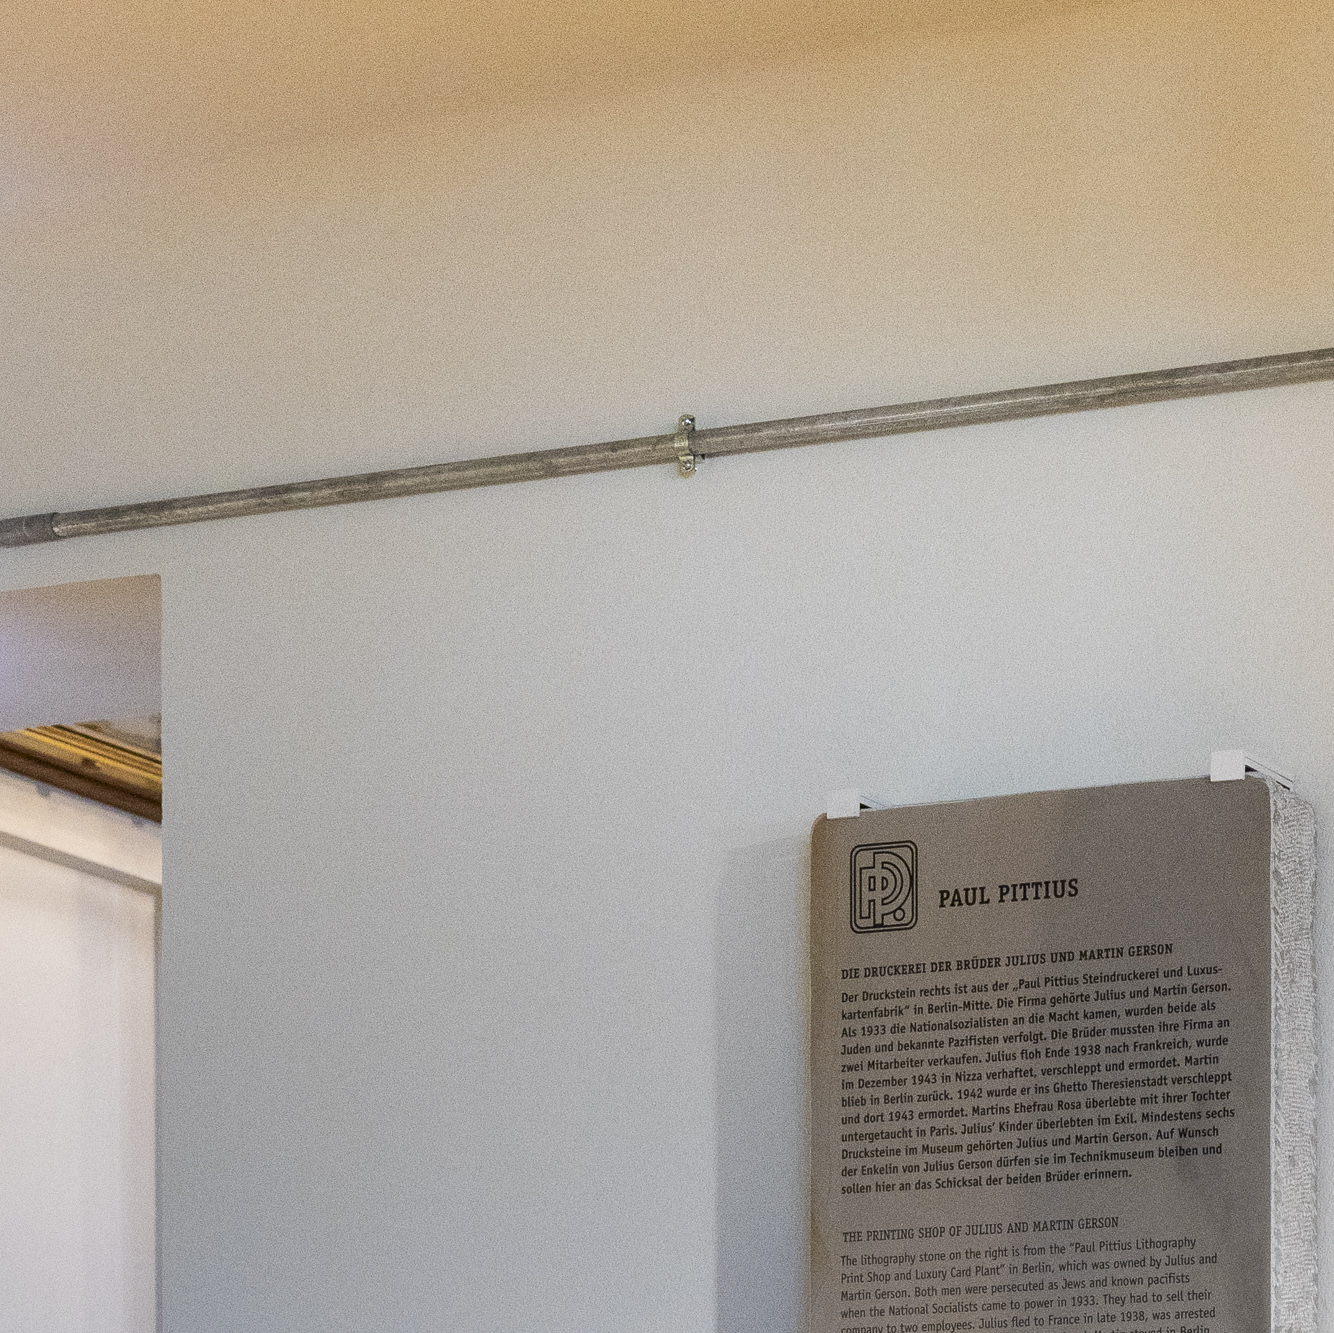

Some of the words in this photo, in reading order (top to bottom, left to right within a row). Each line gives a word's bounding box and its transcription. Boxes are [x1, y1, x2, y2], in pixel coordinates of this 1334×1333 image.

[938, 886, 990, 908] PAUL
[998, 878, 1079, 903] PITTIUS
[840, 966, 859, 978] DIE
[863, 960, 926, 977] DRUCKEREI
[930, 958, 952, 971] DER
[955, 952, 1001, 969] BRÜDER
[1004, 951, 1046, 966] JULIUS
[1050, 949, 1074, 962] UND
[1078, 945, 1124, 960] MARTIN
[1128, 941, 1173, 956] GERSON
[840, 990, 858, 1002] Der
[862, 986, 915, 1001] Druckstein
[919, 983, 951, 997] rechts
[954, 982, 967, 994] ist
[970, 983, 988, 993] aus
[992, 979, 1009, 991] der
[1044, 973, 1079, 987] Pittius
[1082, 967, 1159, 984] Steindruckerei
[1162, 966, 1183, 978] und
[1187, 963, 1222, 977] Luxus-
[913, 1003, 923, 1015] in
[927, 998, 992, 1014] Berlin-Mitte.
[996, 996, 1013, 1008] Die
[1017, 994, 1046, 1007] Firma
[1049, 990, 1090, 1007] gehörte
[1093, 988, 1125, 1001] Julius
[1129, 986, 1149, 999] und
[1153, 983, 1187, 997] Martin
[1191, 980, 1231, 994] Gerson.
[840, 1025, 856, 1037] Als
[861, 1023, 886, 1036] 1933
[889, 1021, 906, 1034] die
[909, 1014, 1008, 1032] Nationalsozialisten
[1012, 1016, 1024, 1025] an
[1028, 1012, 1044, 1024] die
[1048, 1009, 1079, 1022] Macht
[1082, 1006, 1120, 1022] kamen,
[1124, 1003, 1163, 1017] wurden
[1167, 1001, 1196, 1014] beide
[1200, 999, 1215, 1012] als
[840, 1041, 871, 1055] Juden
[874, 1040, 893, 1052] und
[897, 1036, 944, 1051] bekannte
[948, 1032, 999, 1047] Pazifisten
[1002, 1029, 1047, 1046] verfolgt.
[1050, 1028, 1068, 1040] Die
[1071, 1025, 1106, 1039] Brüder
[1110, 1021, 1154, 1036] mussten
[1158, 1020, 1179, 1032] ihre
[1183, 1017, 1213, 1031] Firma
[1216, 1019, 1230, 1028] an
[842, 1229, 862, 1242] THE
[866, 1227, 914, 1240] PRINTING
[918, 1225, 945, 1238] SHOP
[948, 1224, 962, 1236] OF
[964, 1222, 1002, 1235] JULIUS
[1006, 1220, 1028, 1233] AND
[1032, 1218, 1074, 1231] MARTIN
[1077, 1215, 1119, 1229] GERSON
[840, 1253, 857, 1265] The
[860, 1250, 916, 1266] lithography
[919, 1248, 946, 1261] stone
[948, 1250, 961, 1259] on
[964, 1247, 981, 1259] the
[984, 1245, 1008, 1260] right
[1011, 1245, 1020, 1256] is
[1023, 1243, 1046, 1256] from
[1049, 1242, 1066, 1254] the
[1099, 1239, 1132, 1252] Pittius
[1136, 1235, 1195, 1252] Lithography
[840, 1270, 864, 1283] Print
[866, 1269, 891, 1283] Shop
[893, 1268, 911, 1280] and
[915, 1266, 947, 1281] Luxury
[950, 1265, 971, 1277] Card
[1008, 1262, 1018, 1274] in
[1022, 1260, 1054, 1276] Berlin,
[1058, 1259, 1087, 1271] which
[1091, 1260, 1110, 1270] was
[1113, 1256, 1146, 1269] owned
[1149, 1255, 1161, 1269] by
[1164, 1253, 1195, 1266] Julius
[1198, 1252, 1217, 1264] and
[840, 1287, 871, 1300] Martin
[874, 1285, 910, 1298] Gerson.
[914, 1284, 937, 1296] Both
[940, 1286, 961, 1295] men
[964, 1284, 987, 1294] were
[990, 1279, 1044, 1295] persecuted
[1047, 1281, 1058, 1290] as
[1061, 1277, 1086, 1289] Jews
[1089, 1275, 1107, 1288] and
[1111, 1274, 1143, 1286] known
[1147, 1271, 1190, 1287] pacifists
[840, 1305, 865, 1317] when
[869, 1304, 885, 1316] the
[888, 1302, 928, 1315] National
[931, 1300, 978, 1313] Socialists
[981, 1301, 1006, 1311] came
[1009, 1297, 1020, 1309] to
[1024, 1299, 1053, 1311] power
[1057, 1295, 1067, 1307] in
[1071, 1294, 1098, 1306] 1933.
[1103, 1292, 1126, 1307] They
[1129, 1291, 1148, 1303] had
[1151, 1291, 1162, 1302] to
[1166, 1289, 1184, 1302] sell
[1186, 1288, 1212, 1301] their
